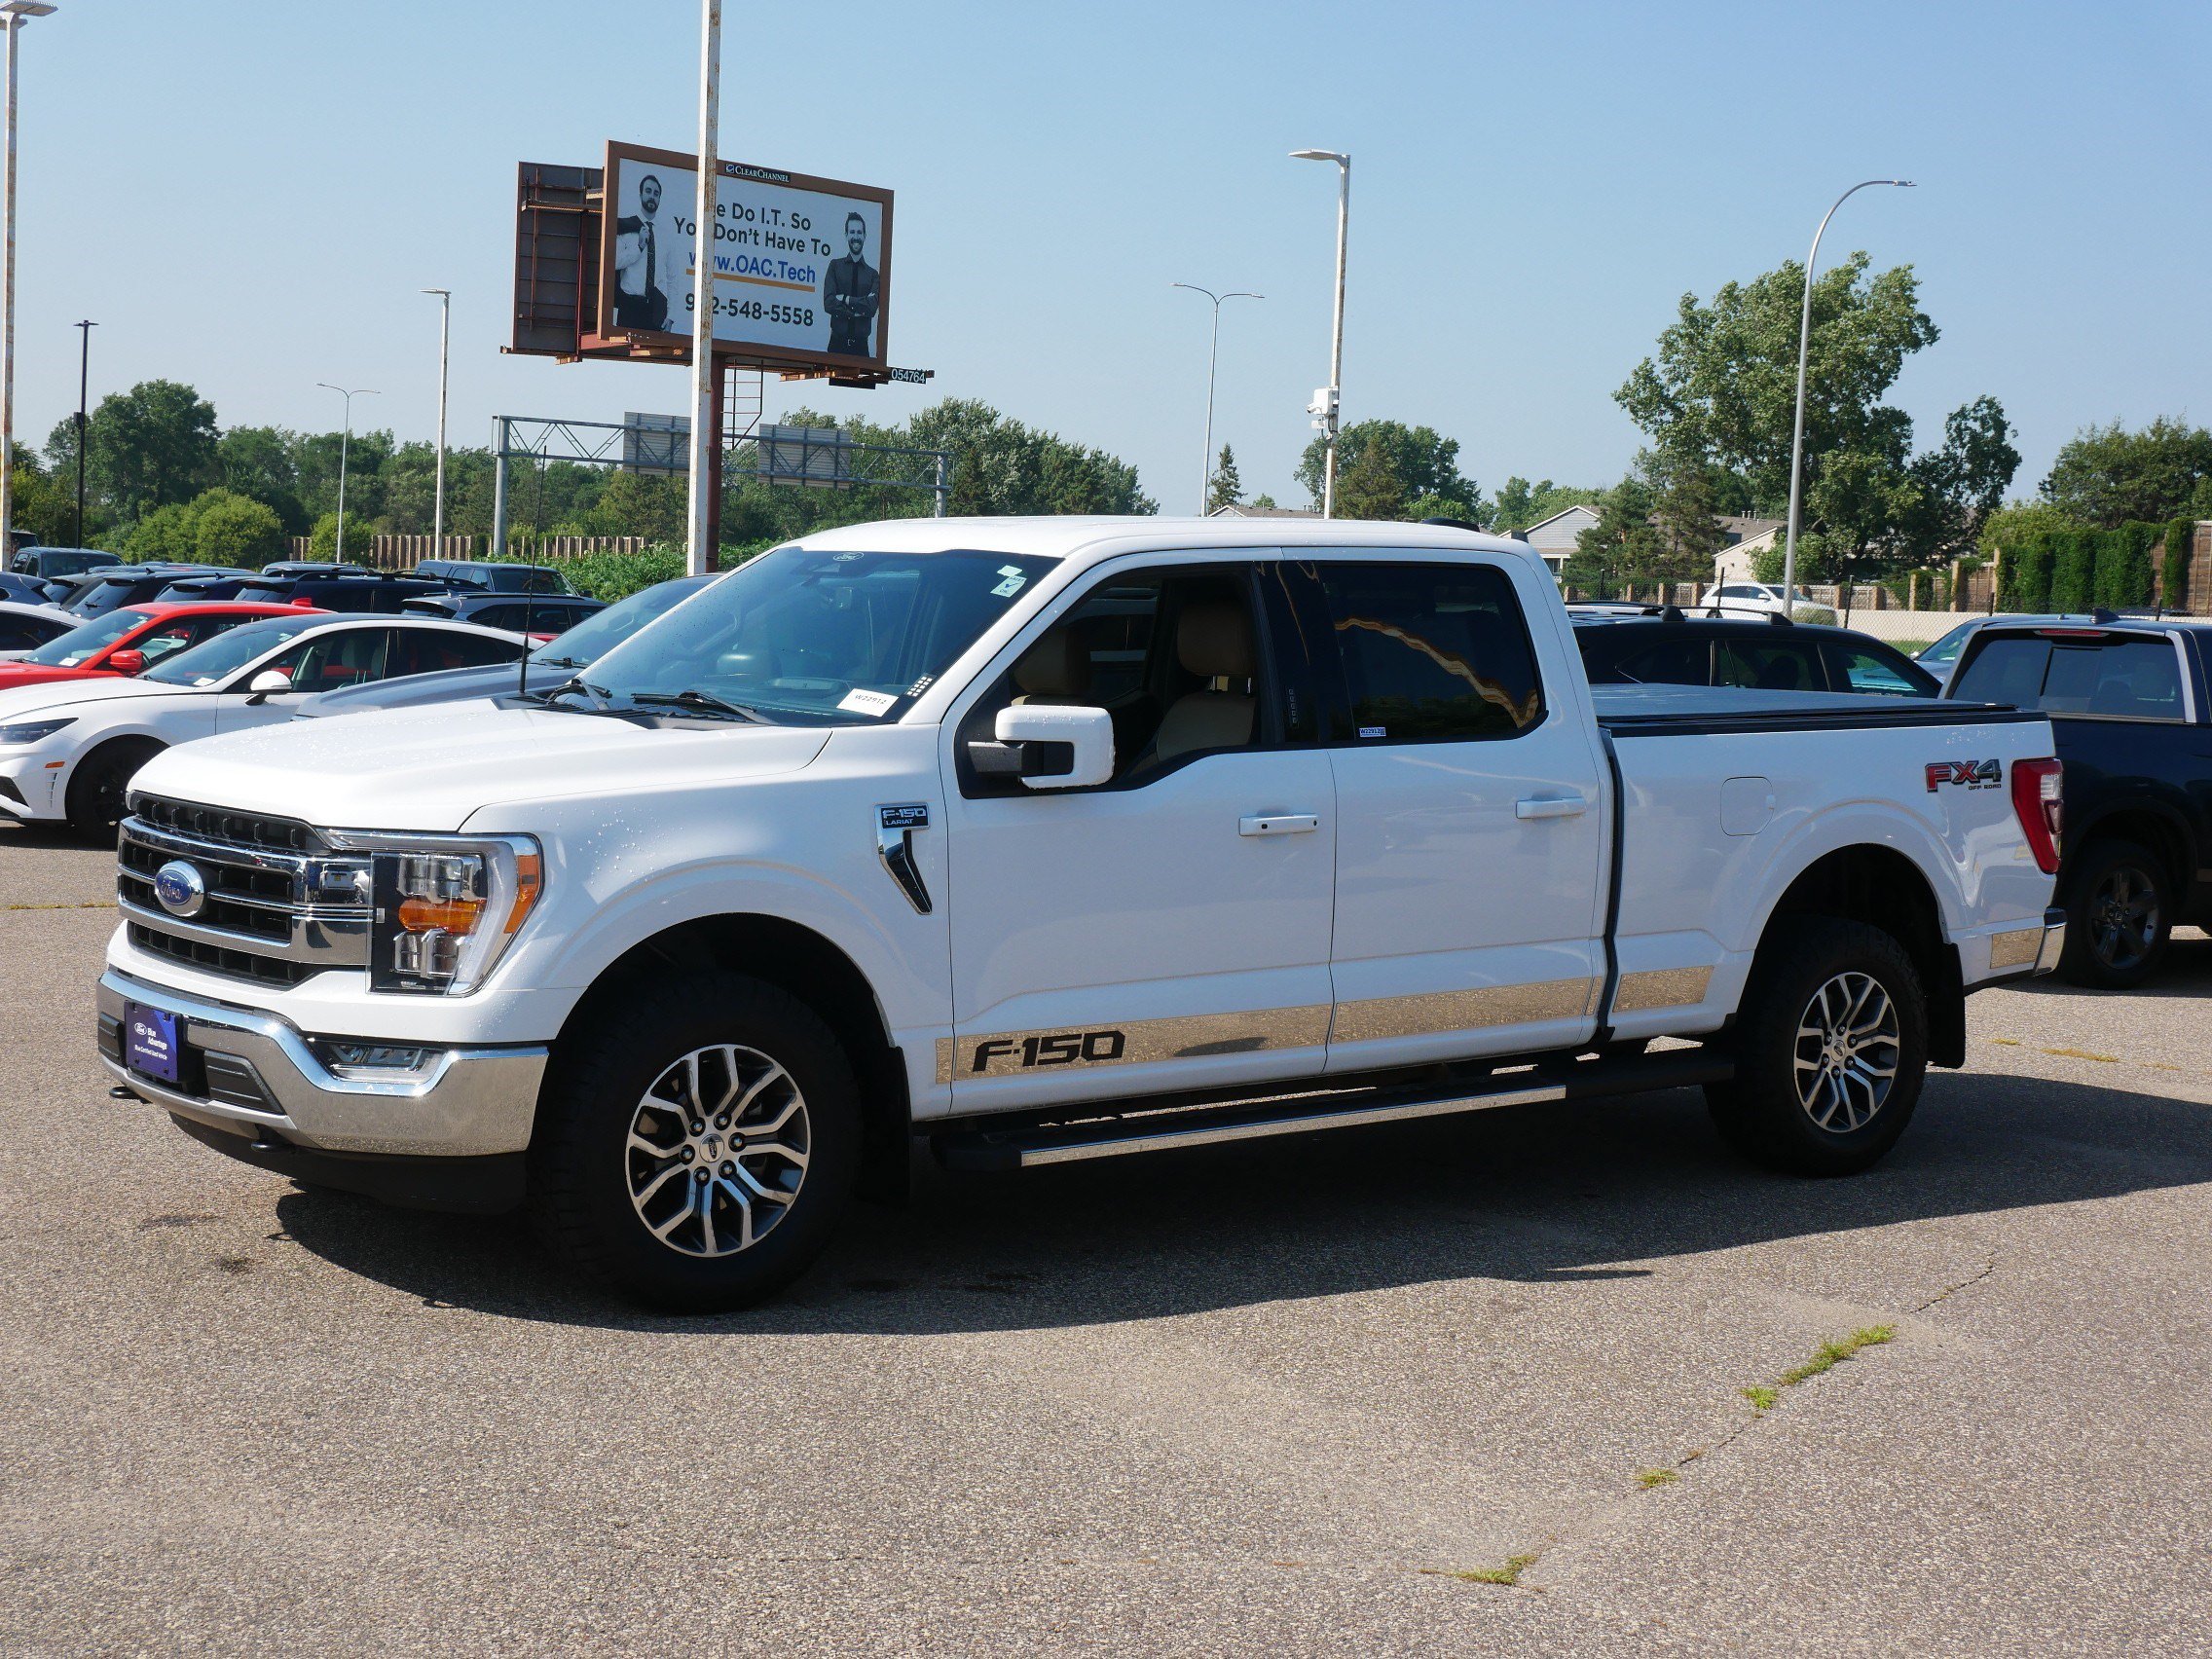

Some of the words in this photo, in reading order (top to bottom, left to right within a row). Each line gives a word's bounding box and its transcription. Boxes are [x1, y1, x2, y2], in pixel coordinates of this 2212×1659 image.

[732, 203, 756, 222] Do
[760, 207, 786, 227] I.T.
[791, 212, 812, 231] So
[674, 216, 697, 237] Yo
[764, 231, 806, 252] Have
[810, 238, 831, 256] To
[688, 251, 816, 283] w.OAC.Tech
[684, 293, 814, 326] 92-548-5558
[891, 369, 926, 383] 054764
[1925, 758, 2002, 793] FX4
[882, 807, 927, 819] F-150
[972, 1030, 1126, 1073] F-150
